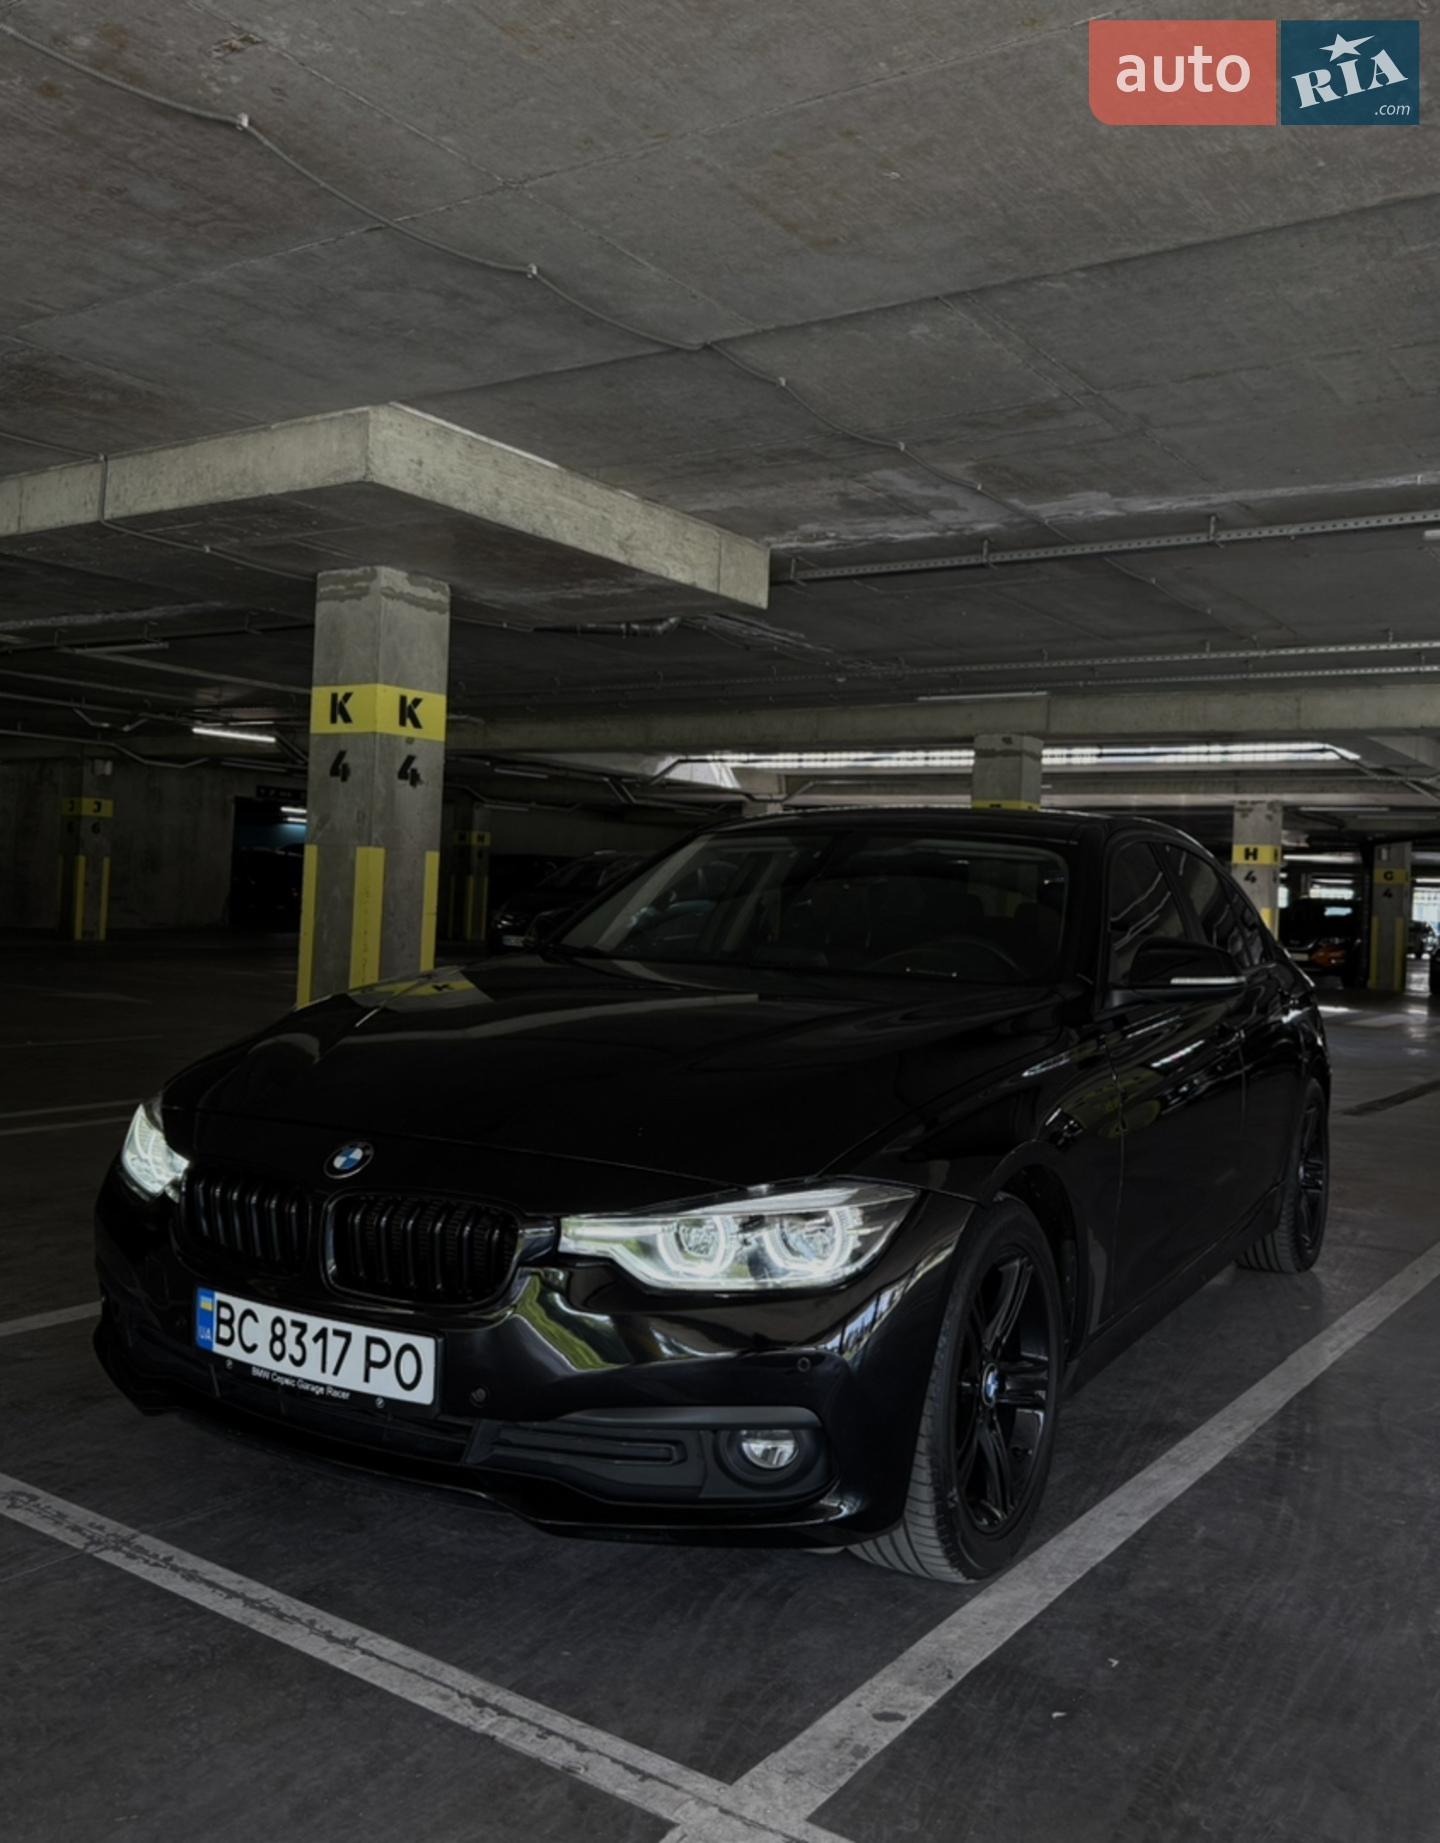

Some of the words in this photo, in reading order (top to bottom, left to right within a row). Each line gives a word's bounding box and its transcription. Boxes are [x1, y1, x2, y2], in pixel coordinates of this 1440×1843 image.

[330, 692, 353, 724] K
[398, 695, 424, 729] K
[329, 751, 350, 782] 4
[397, 755, 421, 787] 4
[1244, 847, 1258, 860] H
[1244, 870, 1257, 883] 4
[215, 1300, 259, 1354] BC
[269, 1316, 352, 1376] 8317
[363, 1335, 423, 1391] PO
